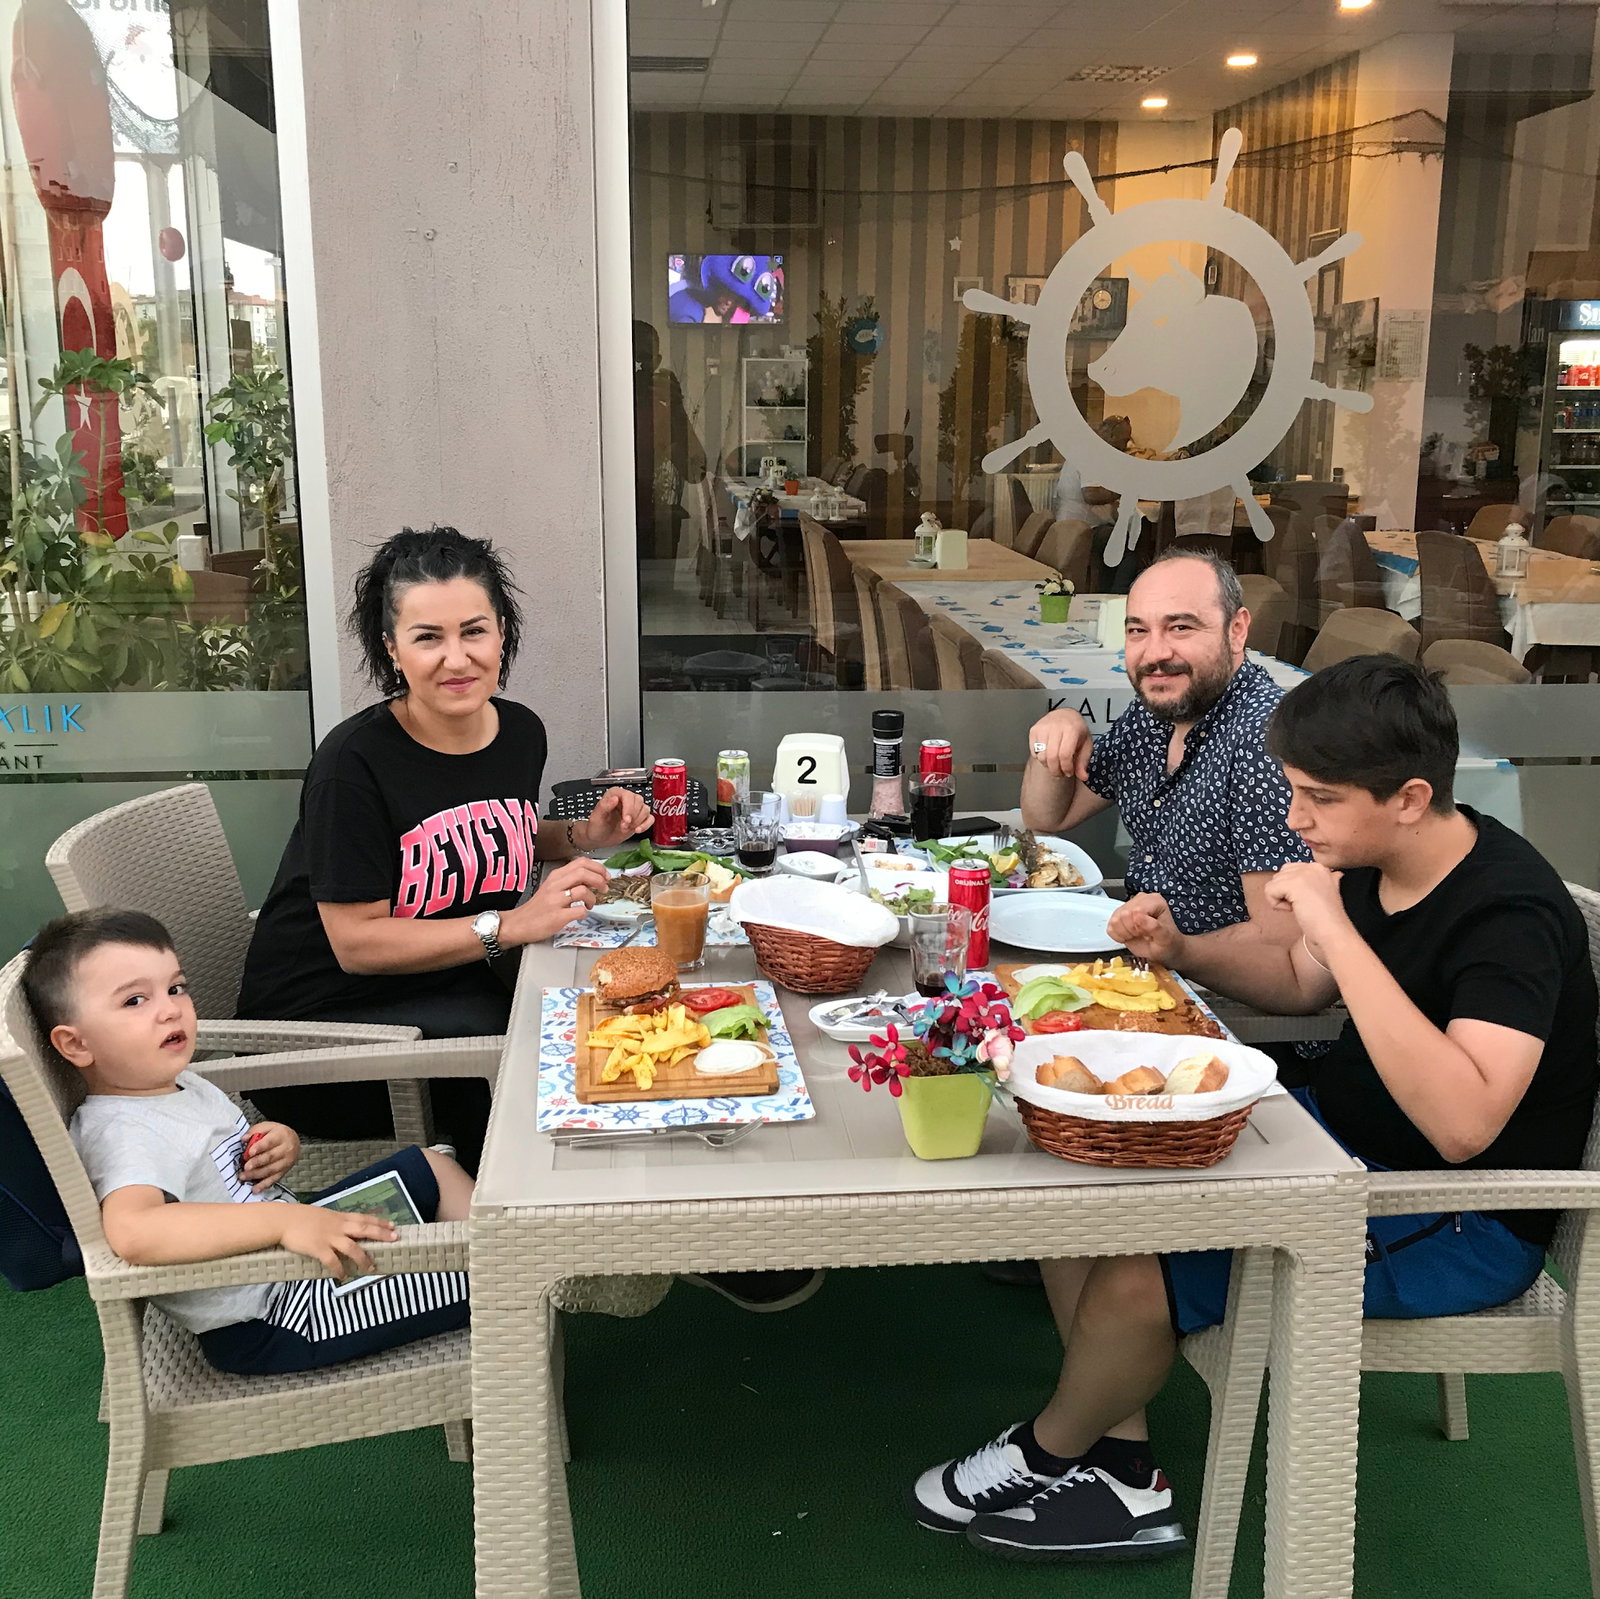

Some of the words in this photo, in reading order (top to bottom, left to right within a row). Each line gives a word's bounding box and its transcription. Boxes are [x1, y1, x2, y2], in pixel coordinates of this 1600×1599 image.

[764, 459, 774, 467] 10
[797, 756, 817, 784] 2
[1105, 1094, 1175, 1110] Bread
